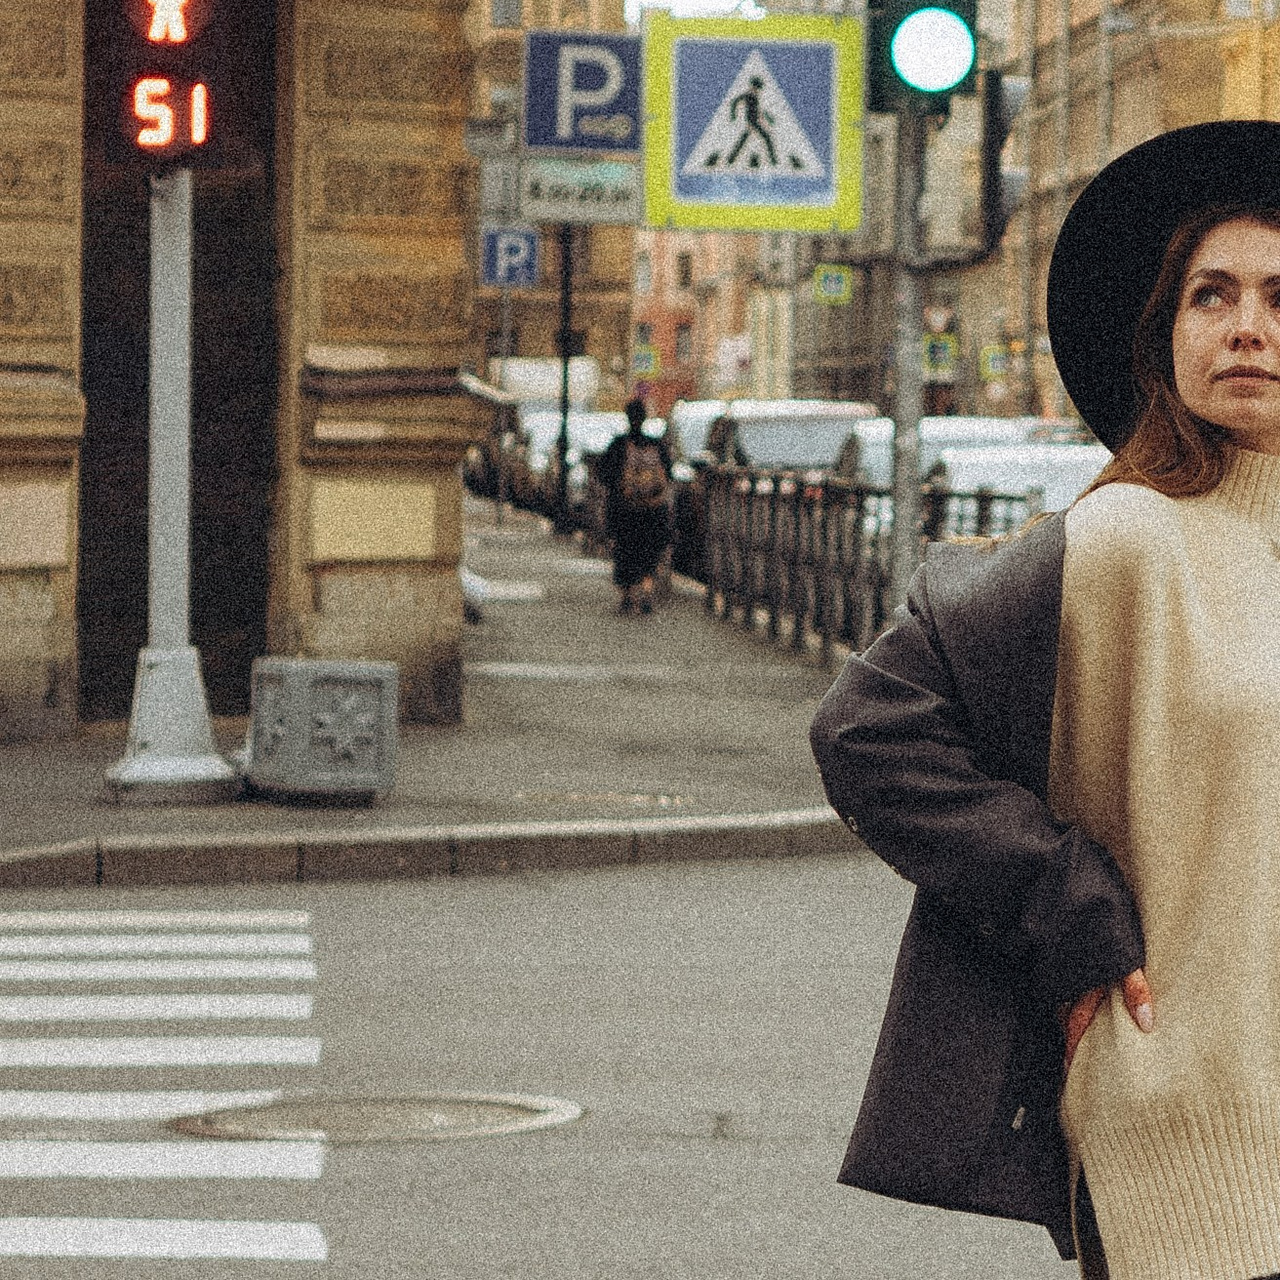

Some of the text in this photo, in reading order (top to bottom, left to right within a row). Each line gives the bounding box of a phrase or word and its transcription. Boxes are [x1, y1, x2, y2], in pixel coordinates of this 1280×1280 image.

[133, 76, 209, 147] 51
[556, 44, 625, 140] P
[496, 231, 528, 281] P
